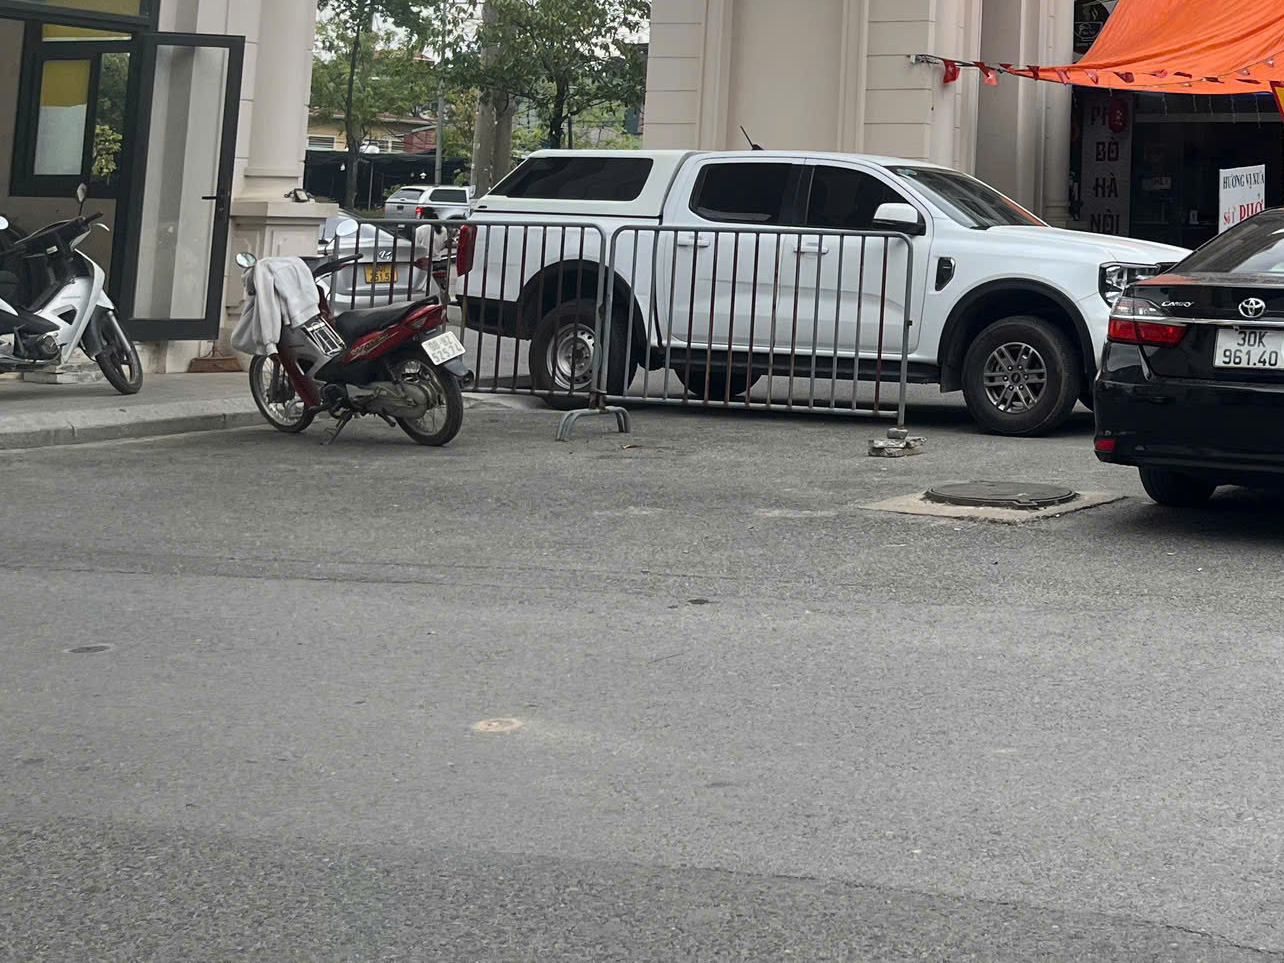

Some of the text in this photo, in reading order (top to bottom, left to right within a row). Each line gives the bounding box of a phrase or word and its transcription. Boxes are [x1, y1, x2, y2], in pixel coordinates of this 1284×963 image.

[1222, 173, 1245, 189] HƯƠNG
[1245, 173, 1253, 189] VỊ
[1236, 330, 1268, 348] 30K
[1222, 348, 1278, 367] 961.40
